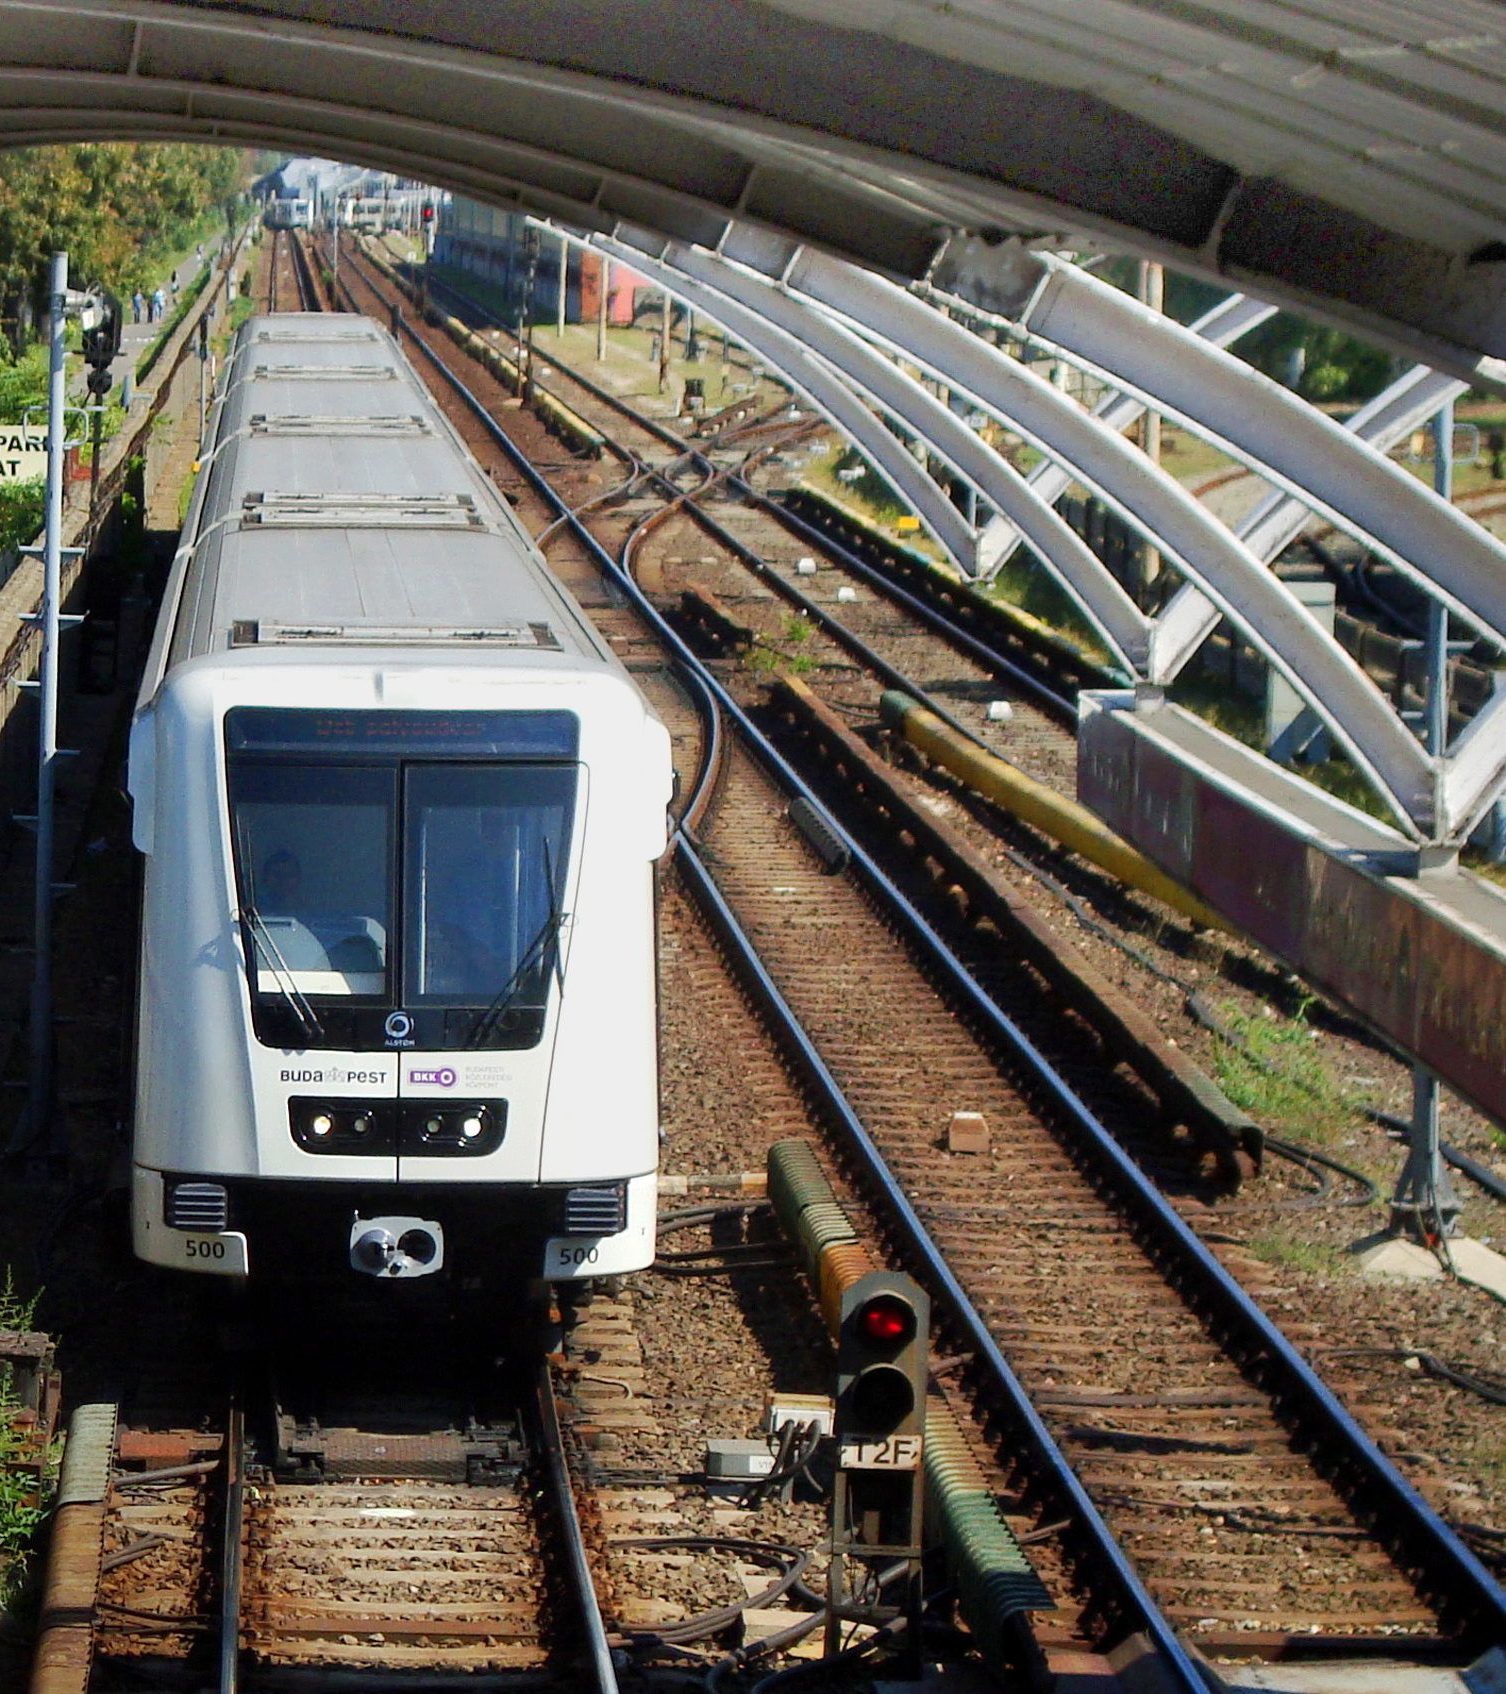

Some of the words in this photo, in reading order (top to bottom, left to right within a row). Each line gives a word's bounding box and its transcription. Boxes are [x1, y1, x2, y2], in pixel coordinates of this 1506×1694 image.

[185, 1239, 225, 1259] 500
[559, 1246, 599, 1265] 500
[850, 1438, 912, 1464] T2F
